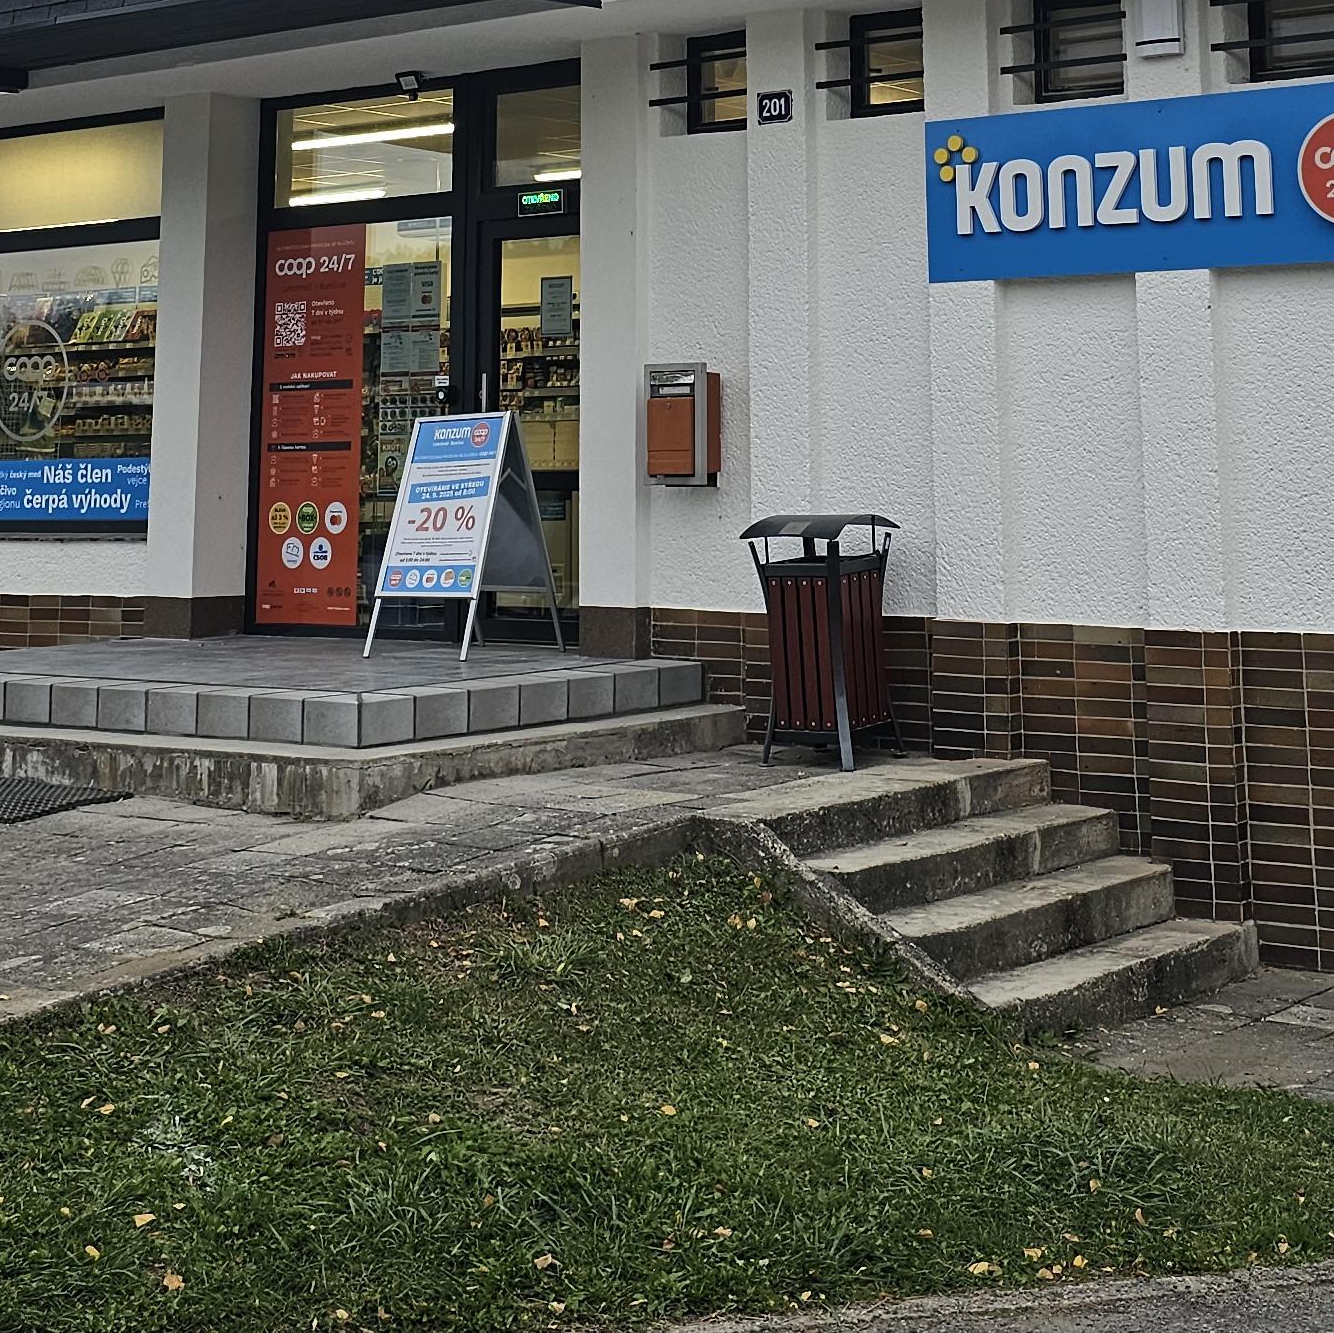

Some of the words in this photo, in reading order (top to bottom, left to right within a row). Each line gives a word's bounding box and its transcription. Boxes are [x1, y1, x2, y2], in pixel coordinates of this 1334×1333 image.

[762, 97, 785, 117] 201
[275, 256, 316, 279] coop
[319, 253, 356, 273] 24/7
[290, 372, 302, 380] JAK
[303, 370, 338, 379] NAKUPOVAT
[43, 463, 73, 484] Náš
[77, 463, 112, 483] člen
[23, 488, 68, 514] čerpá
[72, 488, 131, 514] výhody
[408, 506, 448, 532] -20
[454, 505, 476, 531] %
